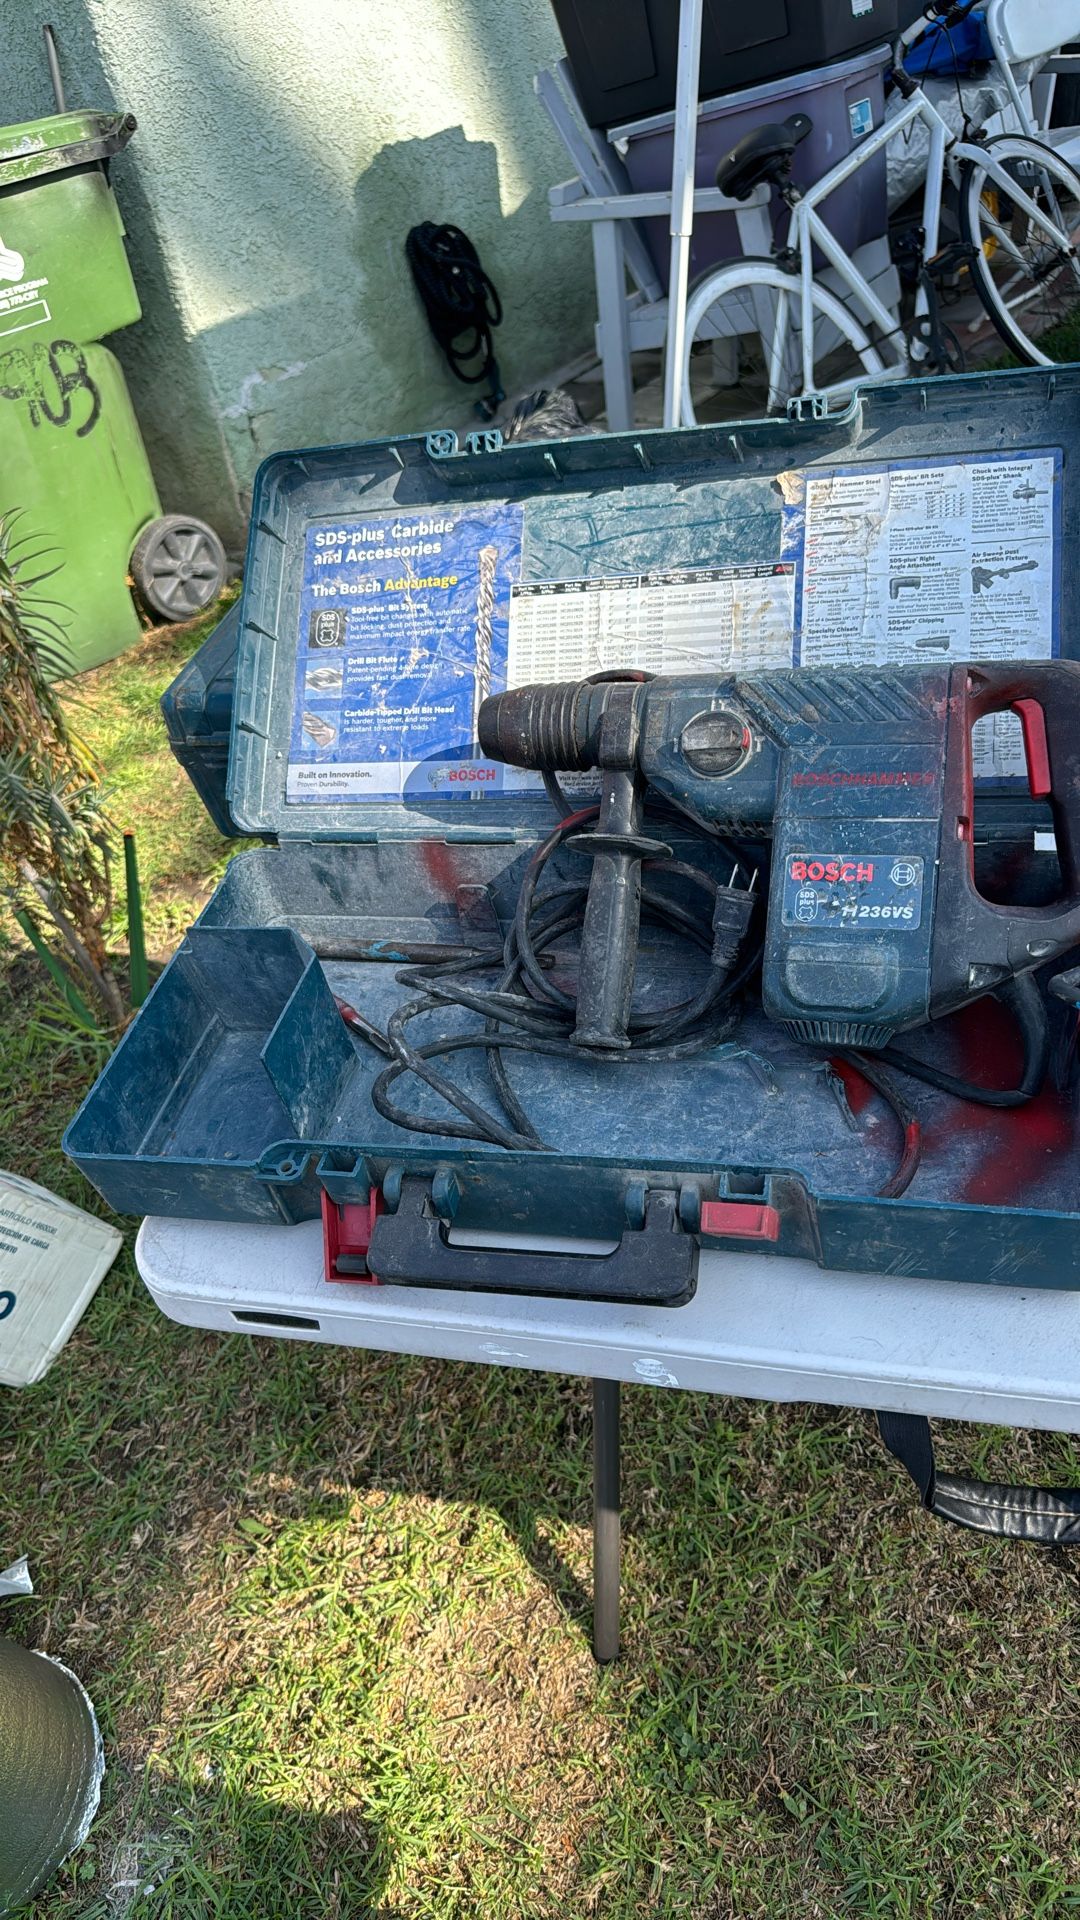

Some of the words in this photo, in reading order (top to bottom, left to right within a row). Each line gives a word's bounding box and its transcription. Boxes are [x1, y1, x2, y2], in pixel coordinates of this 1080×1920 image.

[1008, 464, 1033, 472] Integral
[315, 528, 385, 547] SDS-plus
[391, 519, 454, 538] Carbide
[313, 549, 342, 566] and
[345, 541, 441, 563] Accessories
[982, 550, 1002, 558] Sweep
[972, 556, 1004, 564] Extraction
[312, 584, 337, 597] The
[340, 580, 381, 595] Bosch
[384, 575, 458, 591] Advantage
[388, 604, 400, 612] Bit
[321, 613, 336, 621] SDS
[380, 613, 390, 621] bit
[321, 621, 335, 629] plus
[350, 624, 360, 632] bit
[438, 616, 451, 625] and
[382, 630, 405, 638] impact
[348, 657, 364, 665] Drill
[365, 656, 377, 665] Bit
[378, 656, 398, 664] Flute
[347, 665, 397, 674] Patent-pending
[347, 675, 374, 683] provides
[344, 707, 402, 718] Carbide-Tipped
[404, 706, 420, 715] Drill
[421, 706, 433, 714] Bit
[434, 705, 455, 714] Head
[343, 726, 372, 734] resistant
[298, 771, 317, 779] Built
[329, 770, 373, 778] Innovation.
[448, 769, 496, 783] BOSCH
[319, 781, 350, 789] Durability.
[791, 861, 874, 882] BOSCH
[799, 891, 815, 899] SDS
[799, 898, 815, 906] plus
[22, 1235, 31, 1243] DE
[30, 1238, 50, 1250] CARGA
